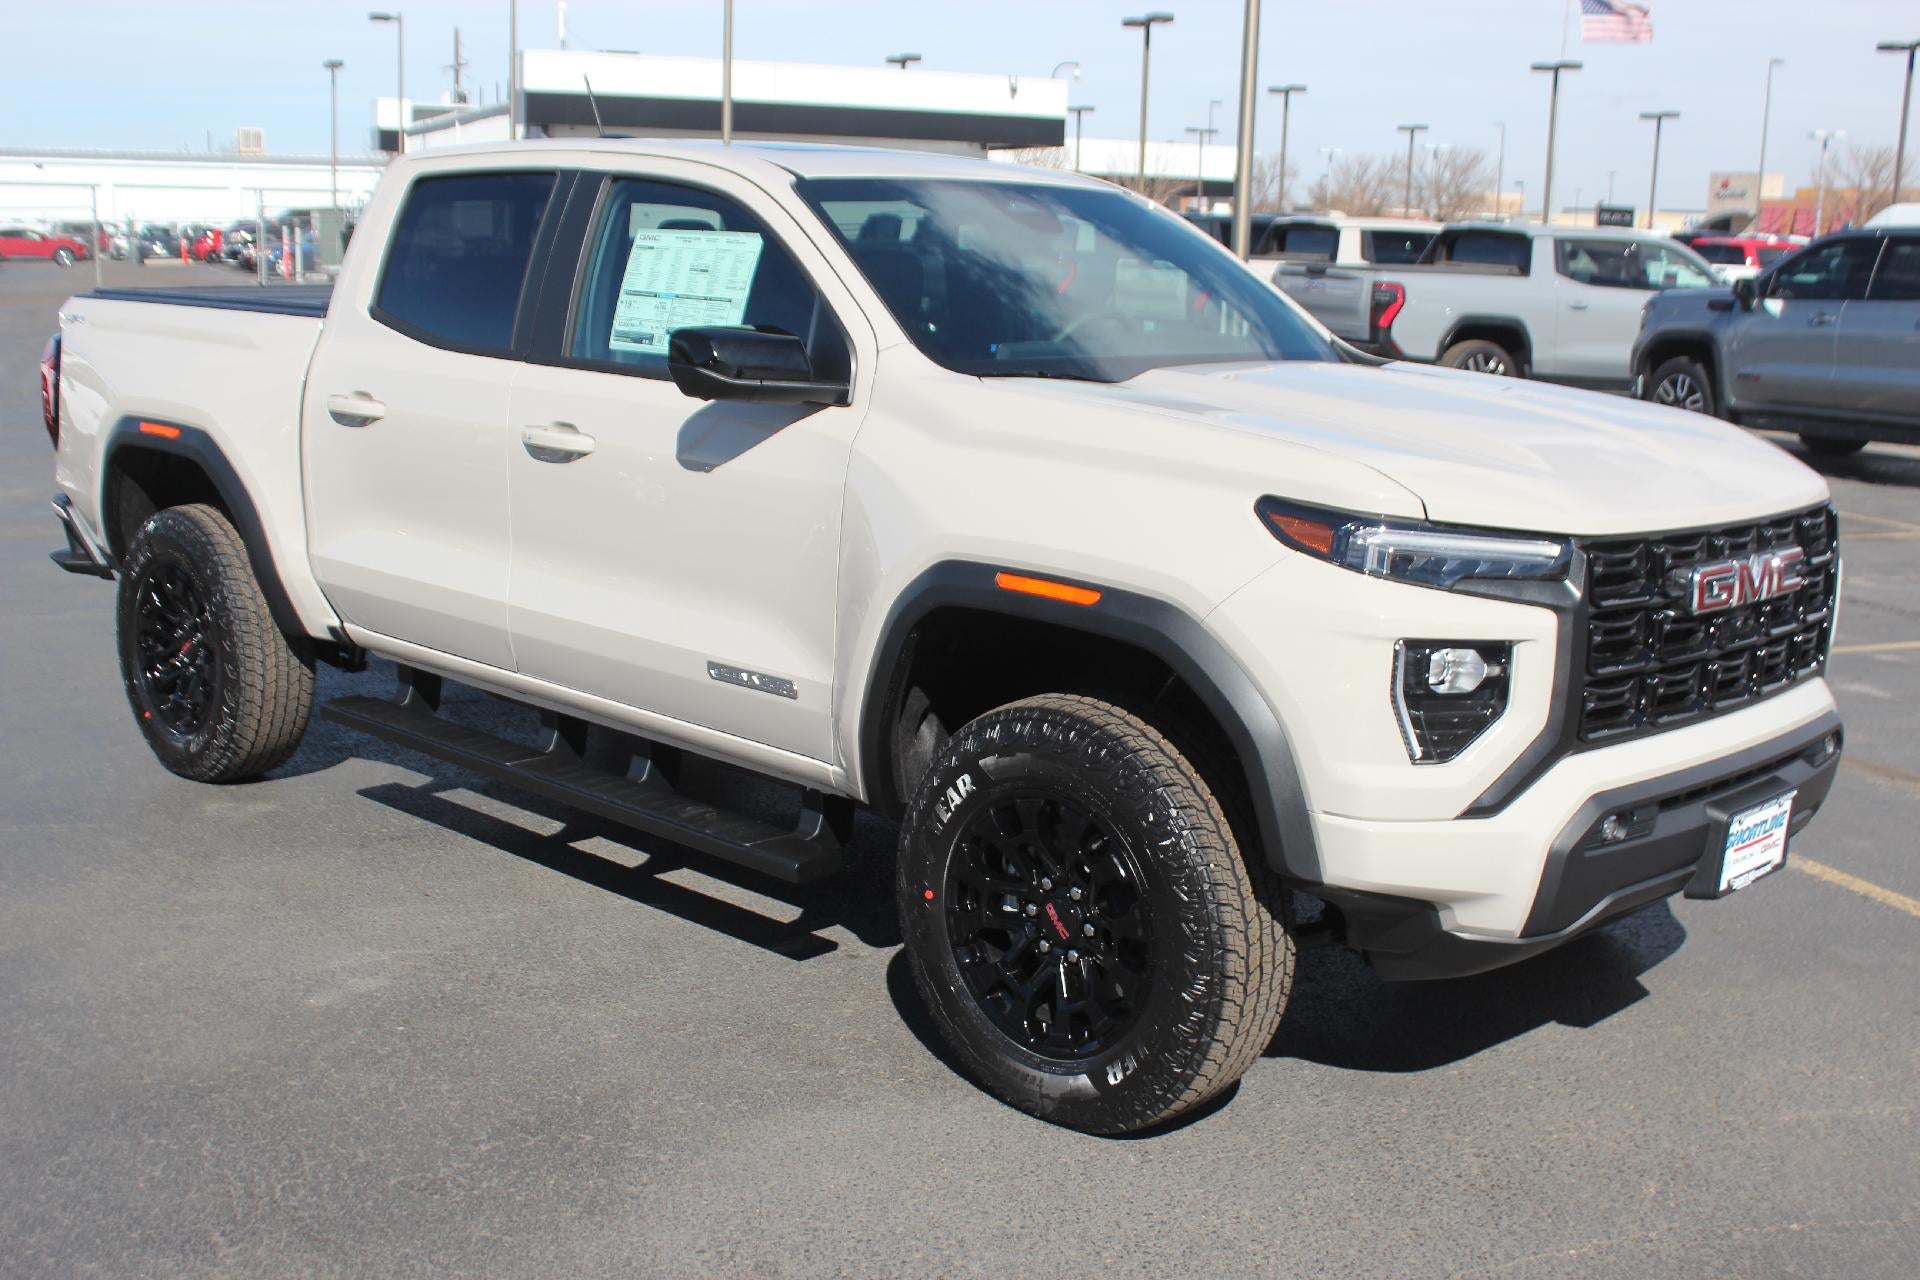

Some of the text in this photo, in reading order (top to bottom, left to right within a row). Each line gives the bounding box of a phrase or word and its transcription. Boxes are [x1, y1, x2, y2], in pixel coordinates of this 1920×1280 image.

[1690, 546, 1804, 615] GMC
[1726, 809, 1788, 849] SHORTLINE
[1045, 902, 1070, 940] GMC
